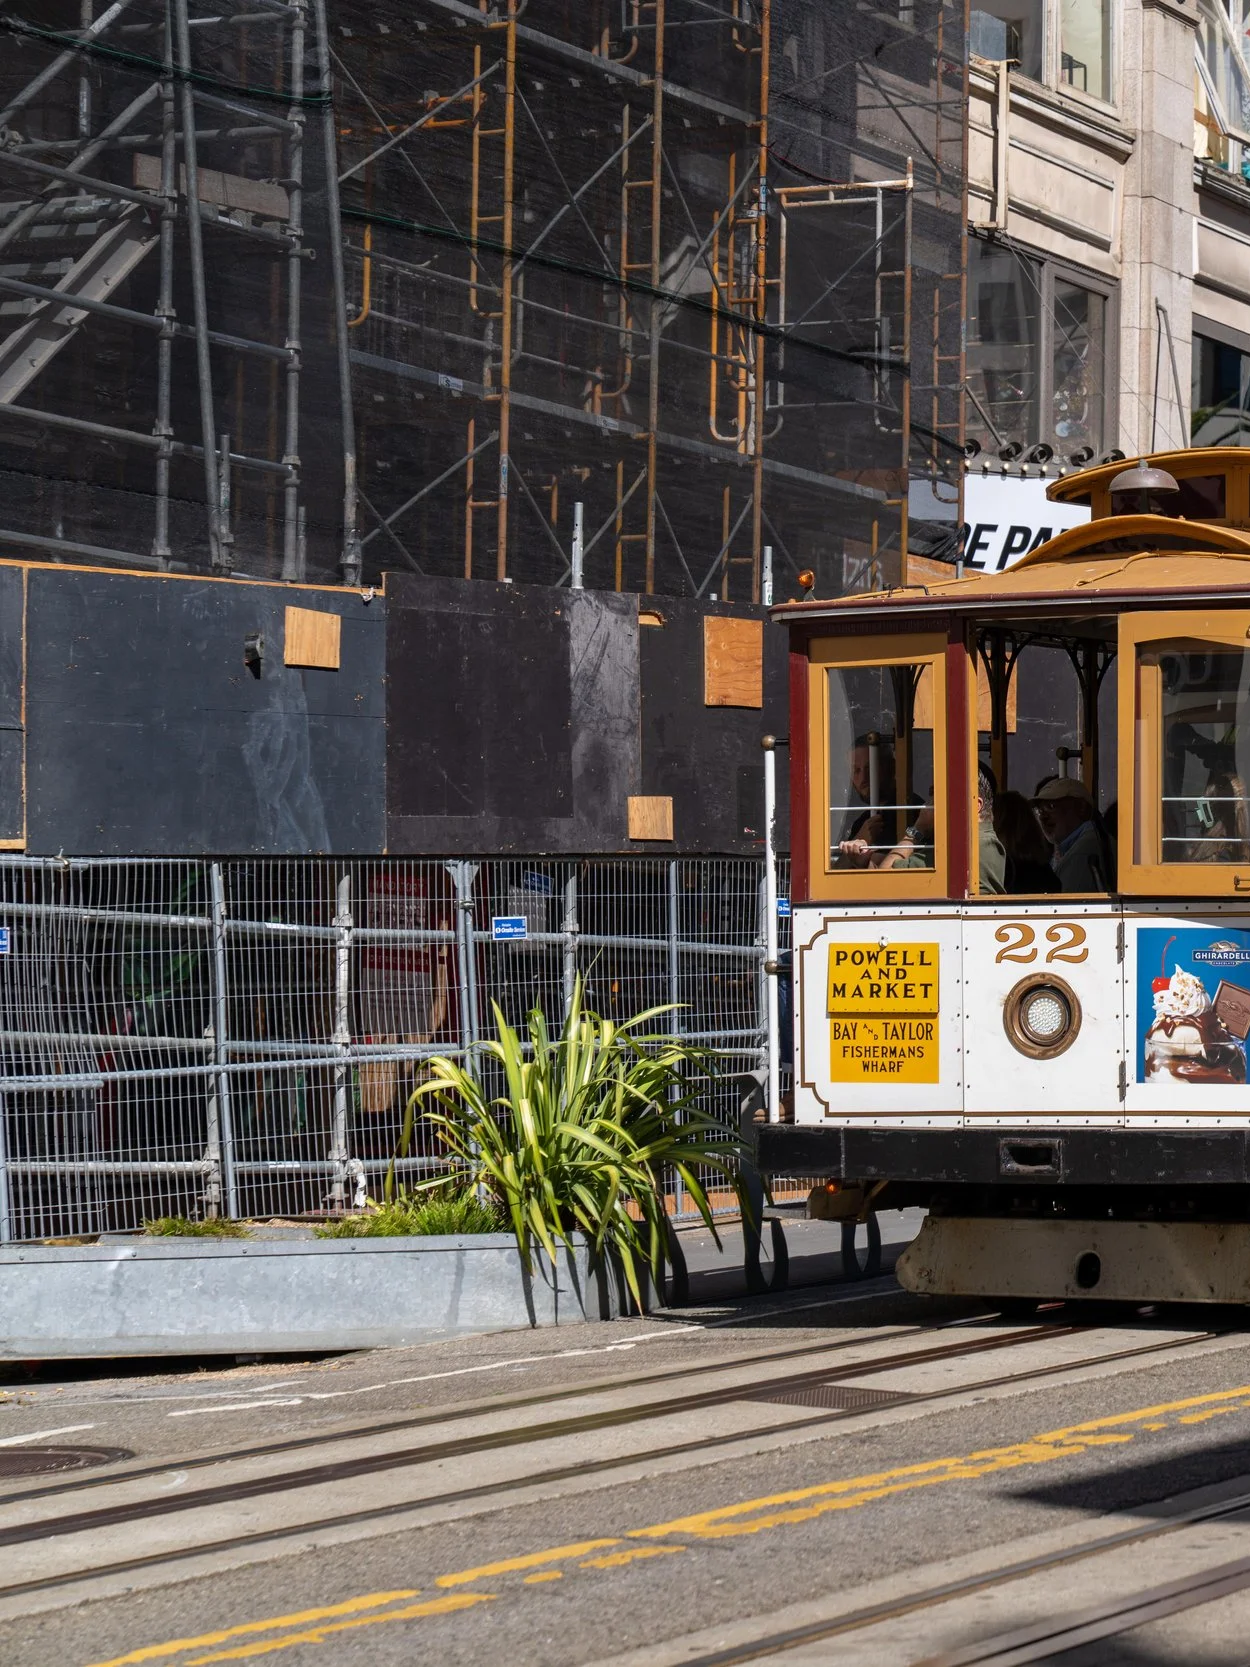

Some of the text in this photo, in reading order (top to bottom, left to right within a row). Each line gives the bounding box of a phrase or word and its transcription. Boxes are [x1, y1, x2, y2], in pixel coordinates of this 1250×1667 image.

[994, 922, 1089, 964] 22
[836, 949, 932, 966] POWELL
[860, 968, 907, 980] AND
[832, 983, 933, 999] MARKET
[833, 1022, 934, 1041] BAY AND TAYLOR
[842, 1045, 924, 1058] FISHERMANS
[862, 1060, 904, 1073] WHARF
